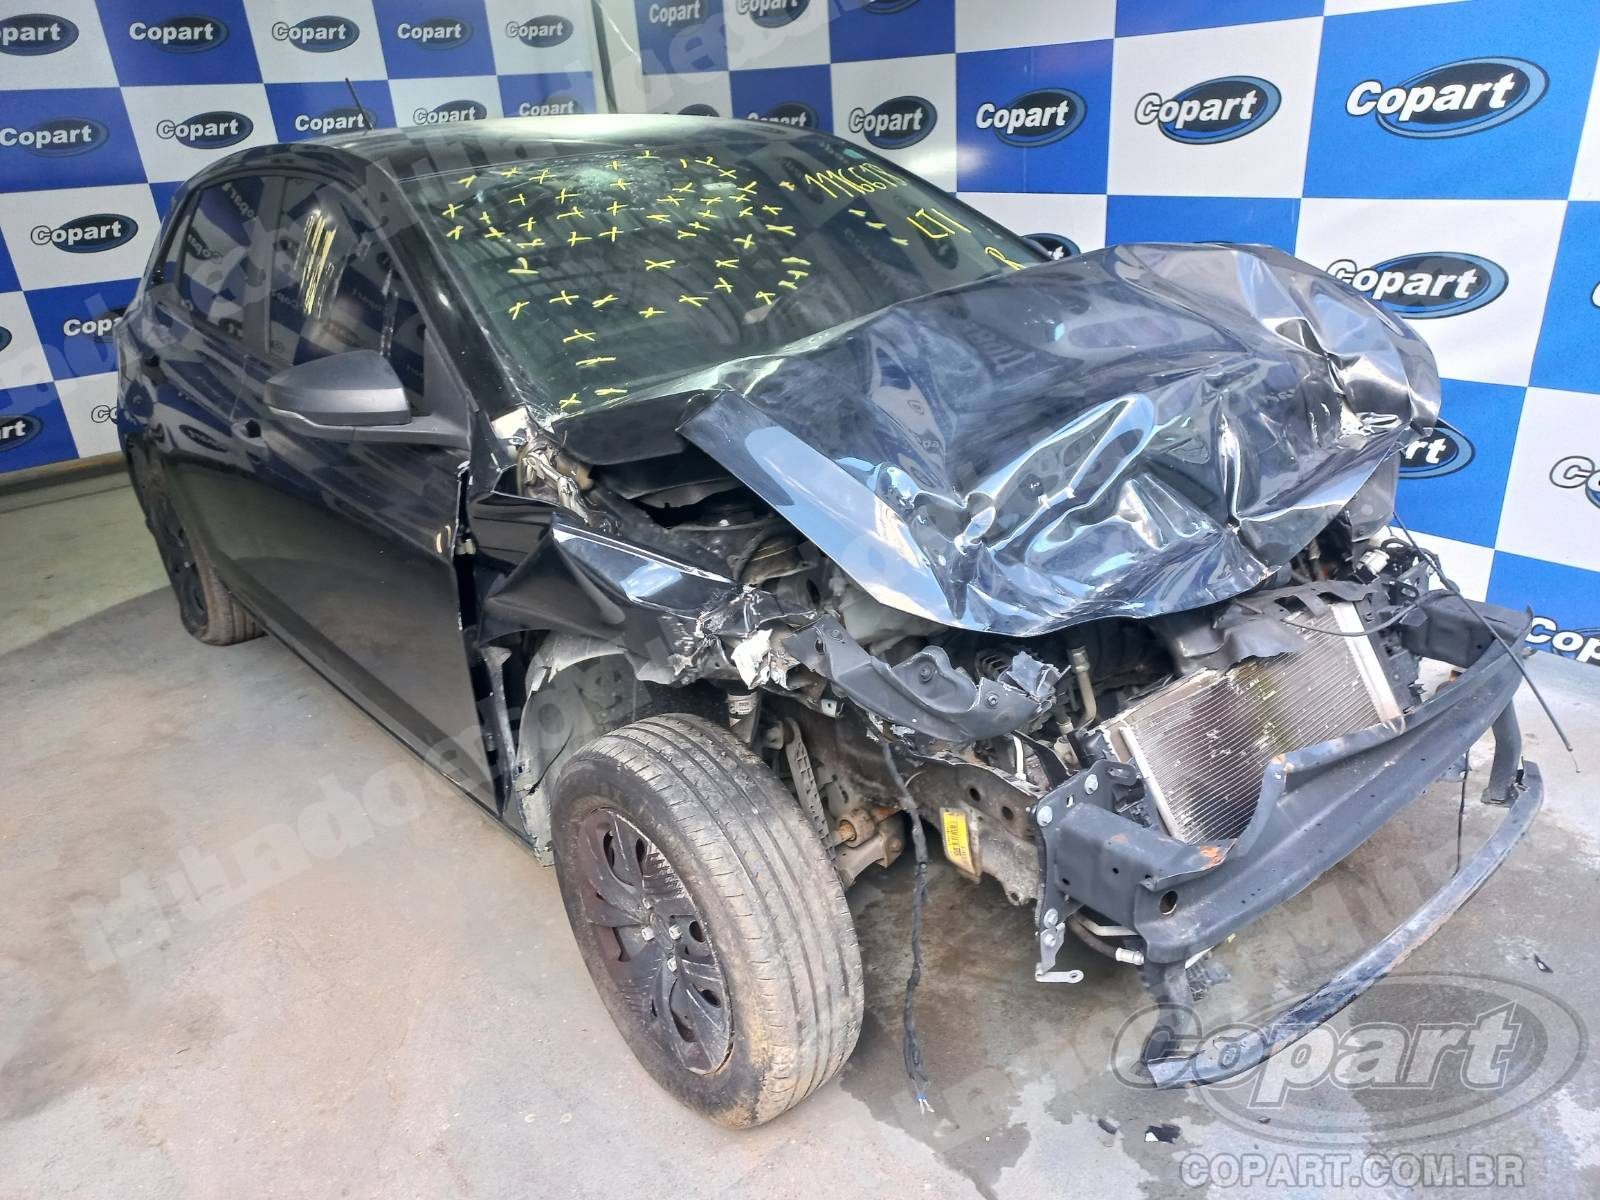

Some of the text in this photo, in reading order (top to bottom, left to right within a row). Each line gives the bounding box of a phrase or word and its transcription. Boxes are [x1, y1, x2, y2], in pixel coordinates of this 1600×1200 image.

[649, 1, 702, 26] Copart
[0, 22, 61, 46] part
[128, 22, 214, 44] Copart
[272, 21, 347, 41] Copart
[397, 23, 462, 40] Copart
[506, 21, 564, 39] Copart
[518, 100, 575, 118] Copart
[1134, 88, 1258, 127] Copart
[1346, 71, 1516, 125] Copart
[294, 113, 366, 133] Copart
[413, 105, 476, 125] Copart
[849, 106, 924, 137] Copart
[975, 100, 1069, 134] Copart
[0, 124, 92, 149] Copart
[156, 118, 240, 140] Copart
[30, 218, 122, 245] Copart
